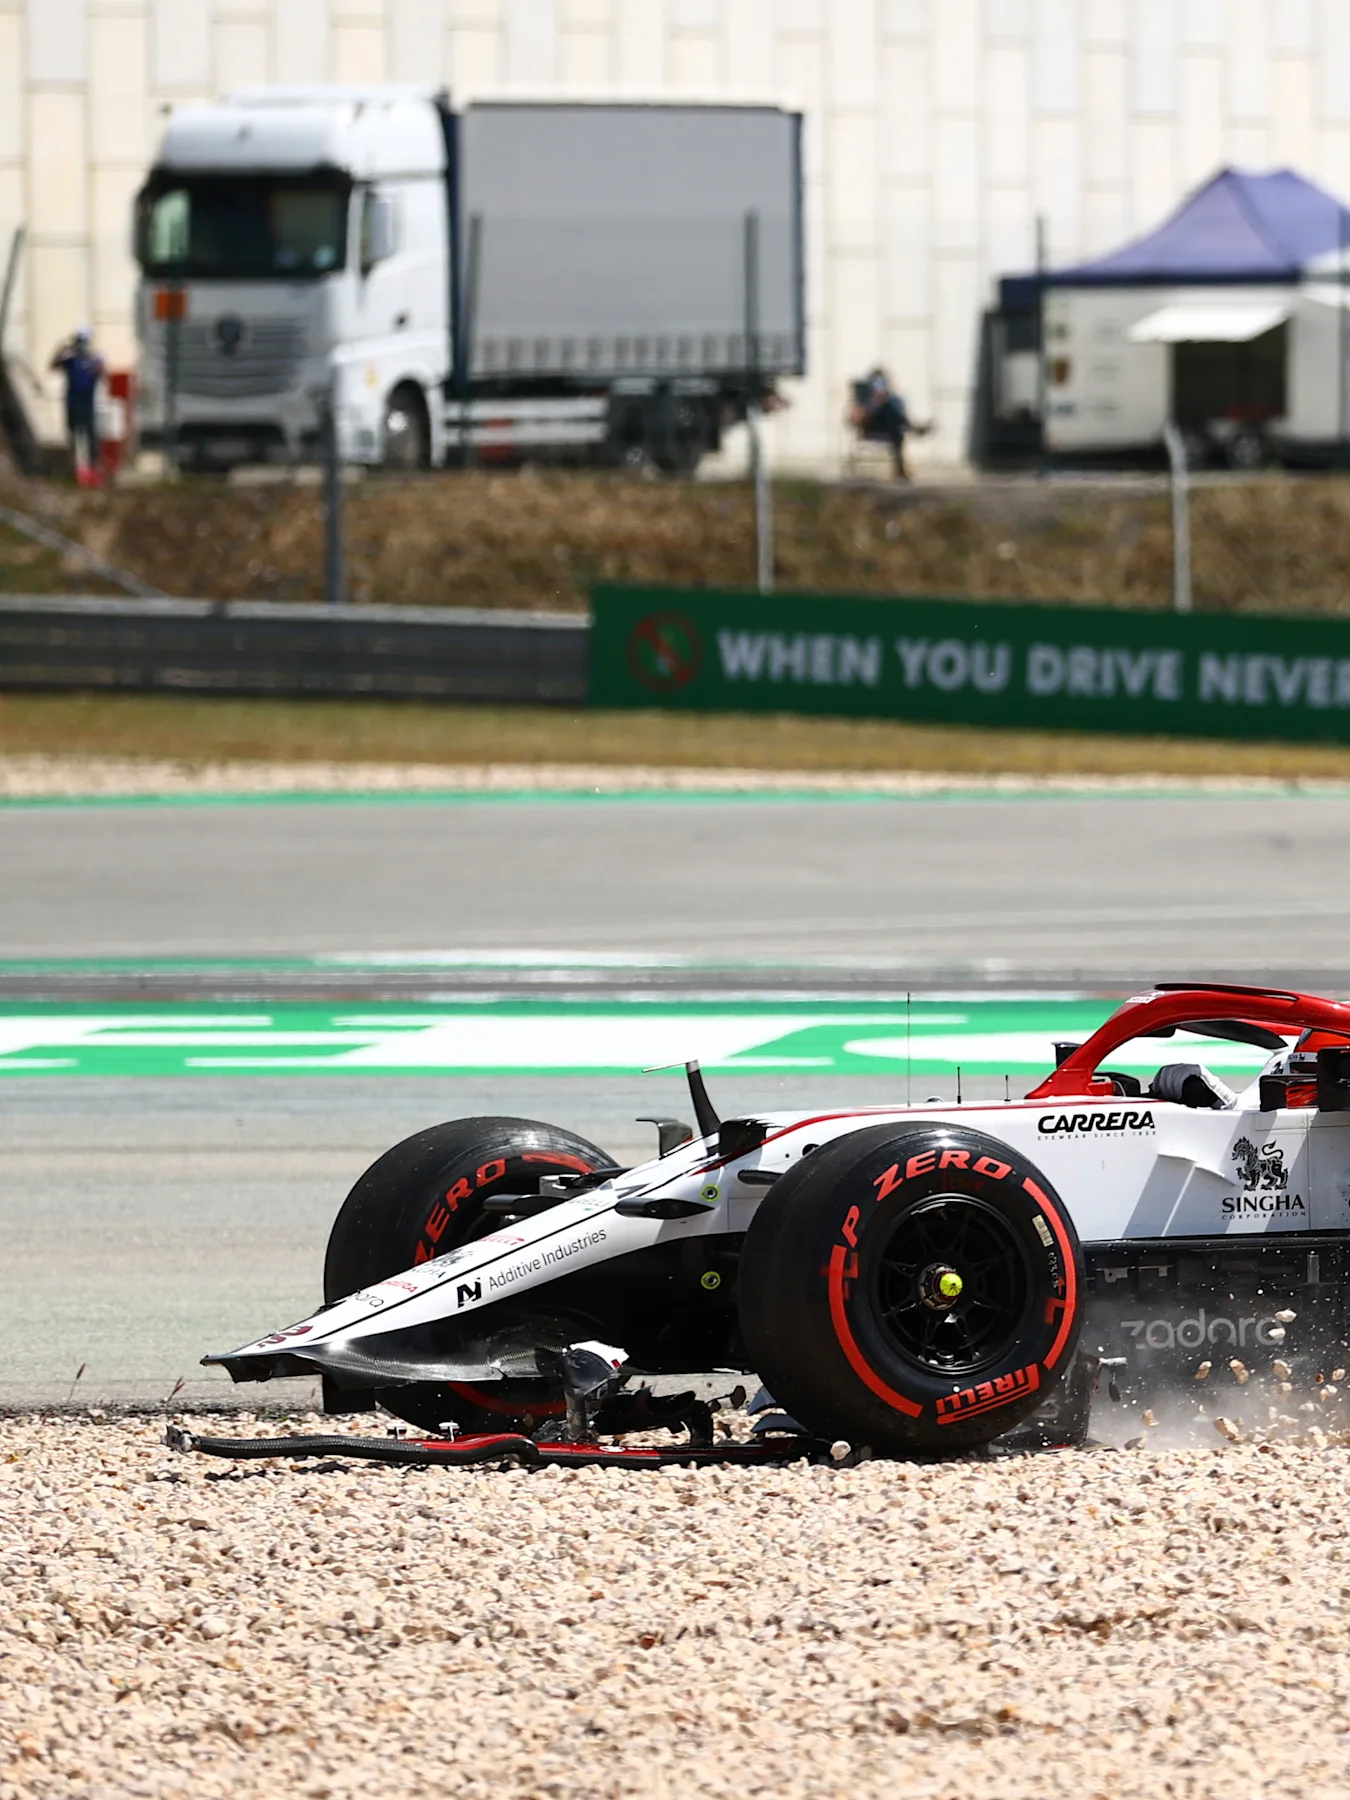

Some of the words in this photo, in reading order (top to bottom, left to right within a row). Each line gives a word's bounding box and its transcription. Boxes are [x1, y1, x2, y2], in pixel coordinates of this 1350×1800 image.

[717, 630, 881, 686] WHEN
[896, 635, 1011, 692] YOU
[1027, 641, 1182, 700] DRIVE
[1037, 1111, 1156, 1133] CARRERA
[841, 1204, 861, 1248] P
[873, 1150, 1013, 1201] ZERO
[1222, 1194, 1305, 1213] SINGHA
[1222, 1212, 1306, 1220] CORPORATION
[489, 1258, 541, 1291] Additive
[541, 1229, 606, 1266] Industries
[1120, 1309, 1284, 1348] zadara
[936, 1363, 1040, 1425] PIRELLI
